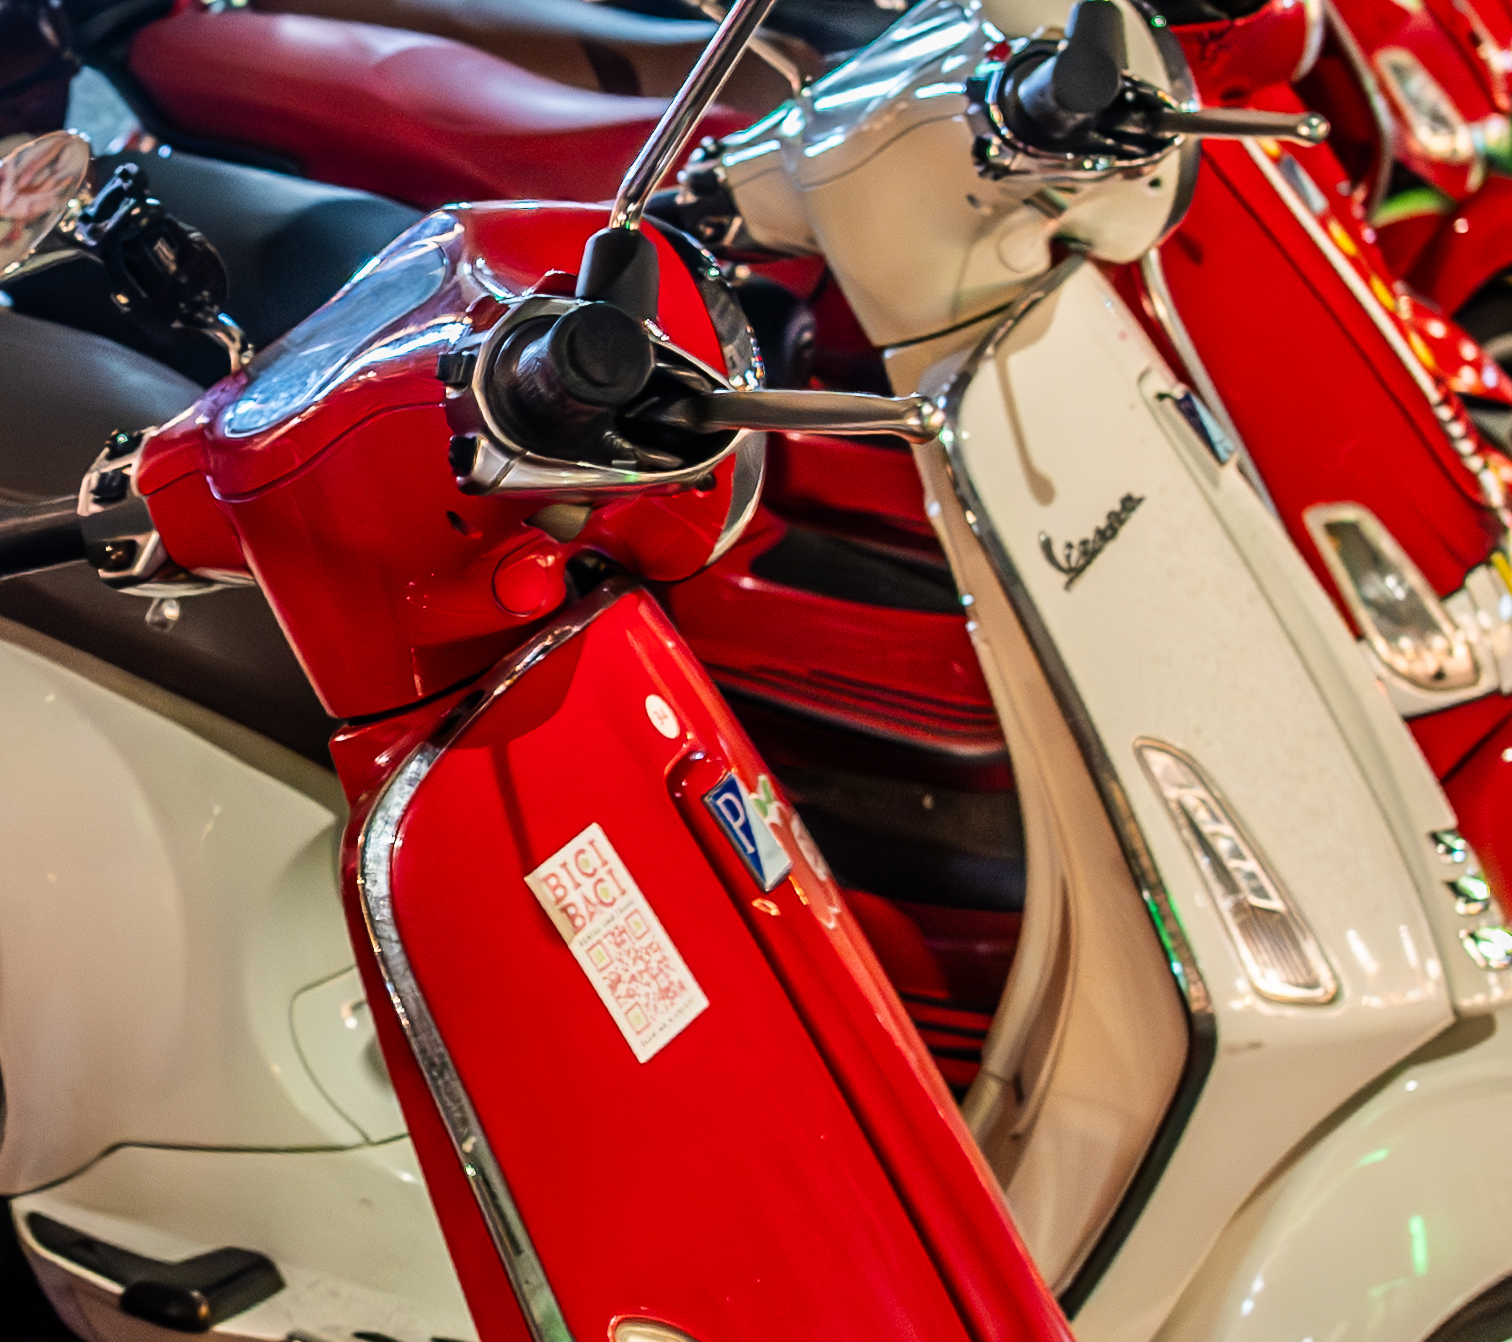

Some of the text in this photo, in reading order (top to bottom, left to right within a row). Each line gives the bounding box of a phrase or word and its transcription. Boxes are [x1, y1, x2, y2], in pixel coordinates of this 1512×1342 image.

[1039, 492, 1145, 591] Vespa
[541, 838, 608, 906] BICI
[559, 867, 627, 933] BACI
